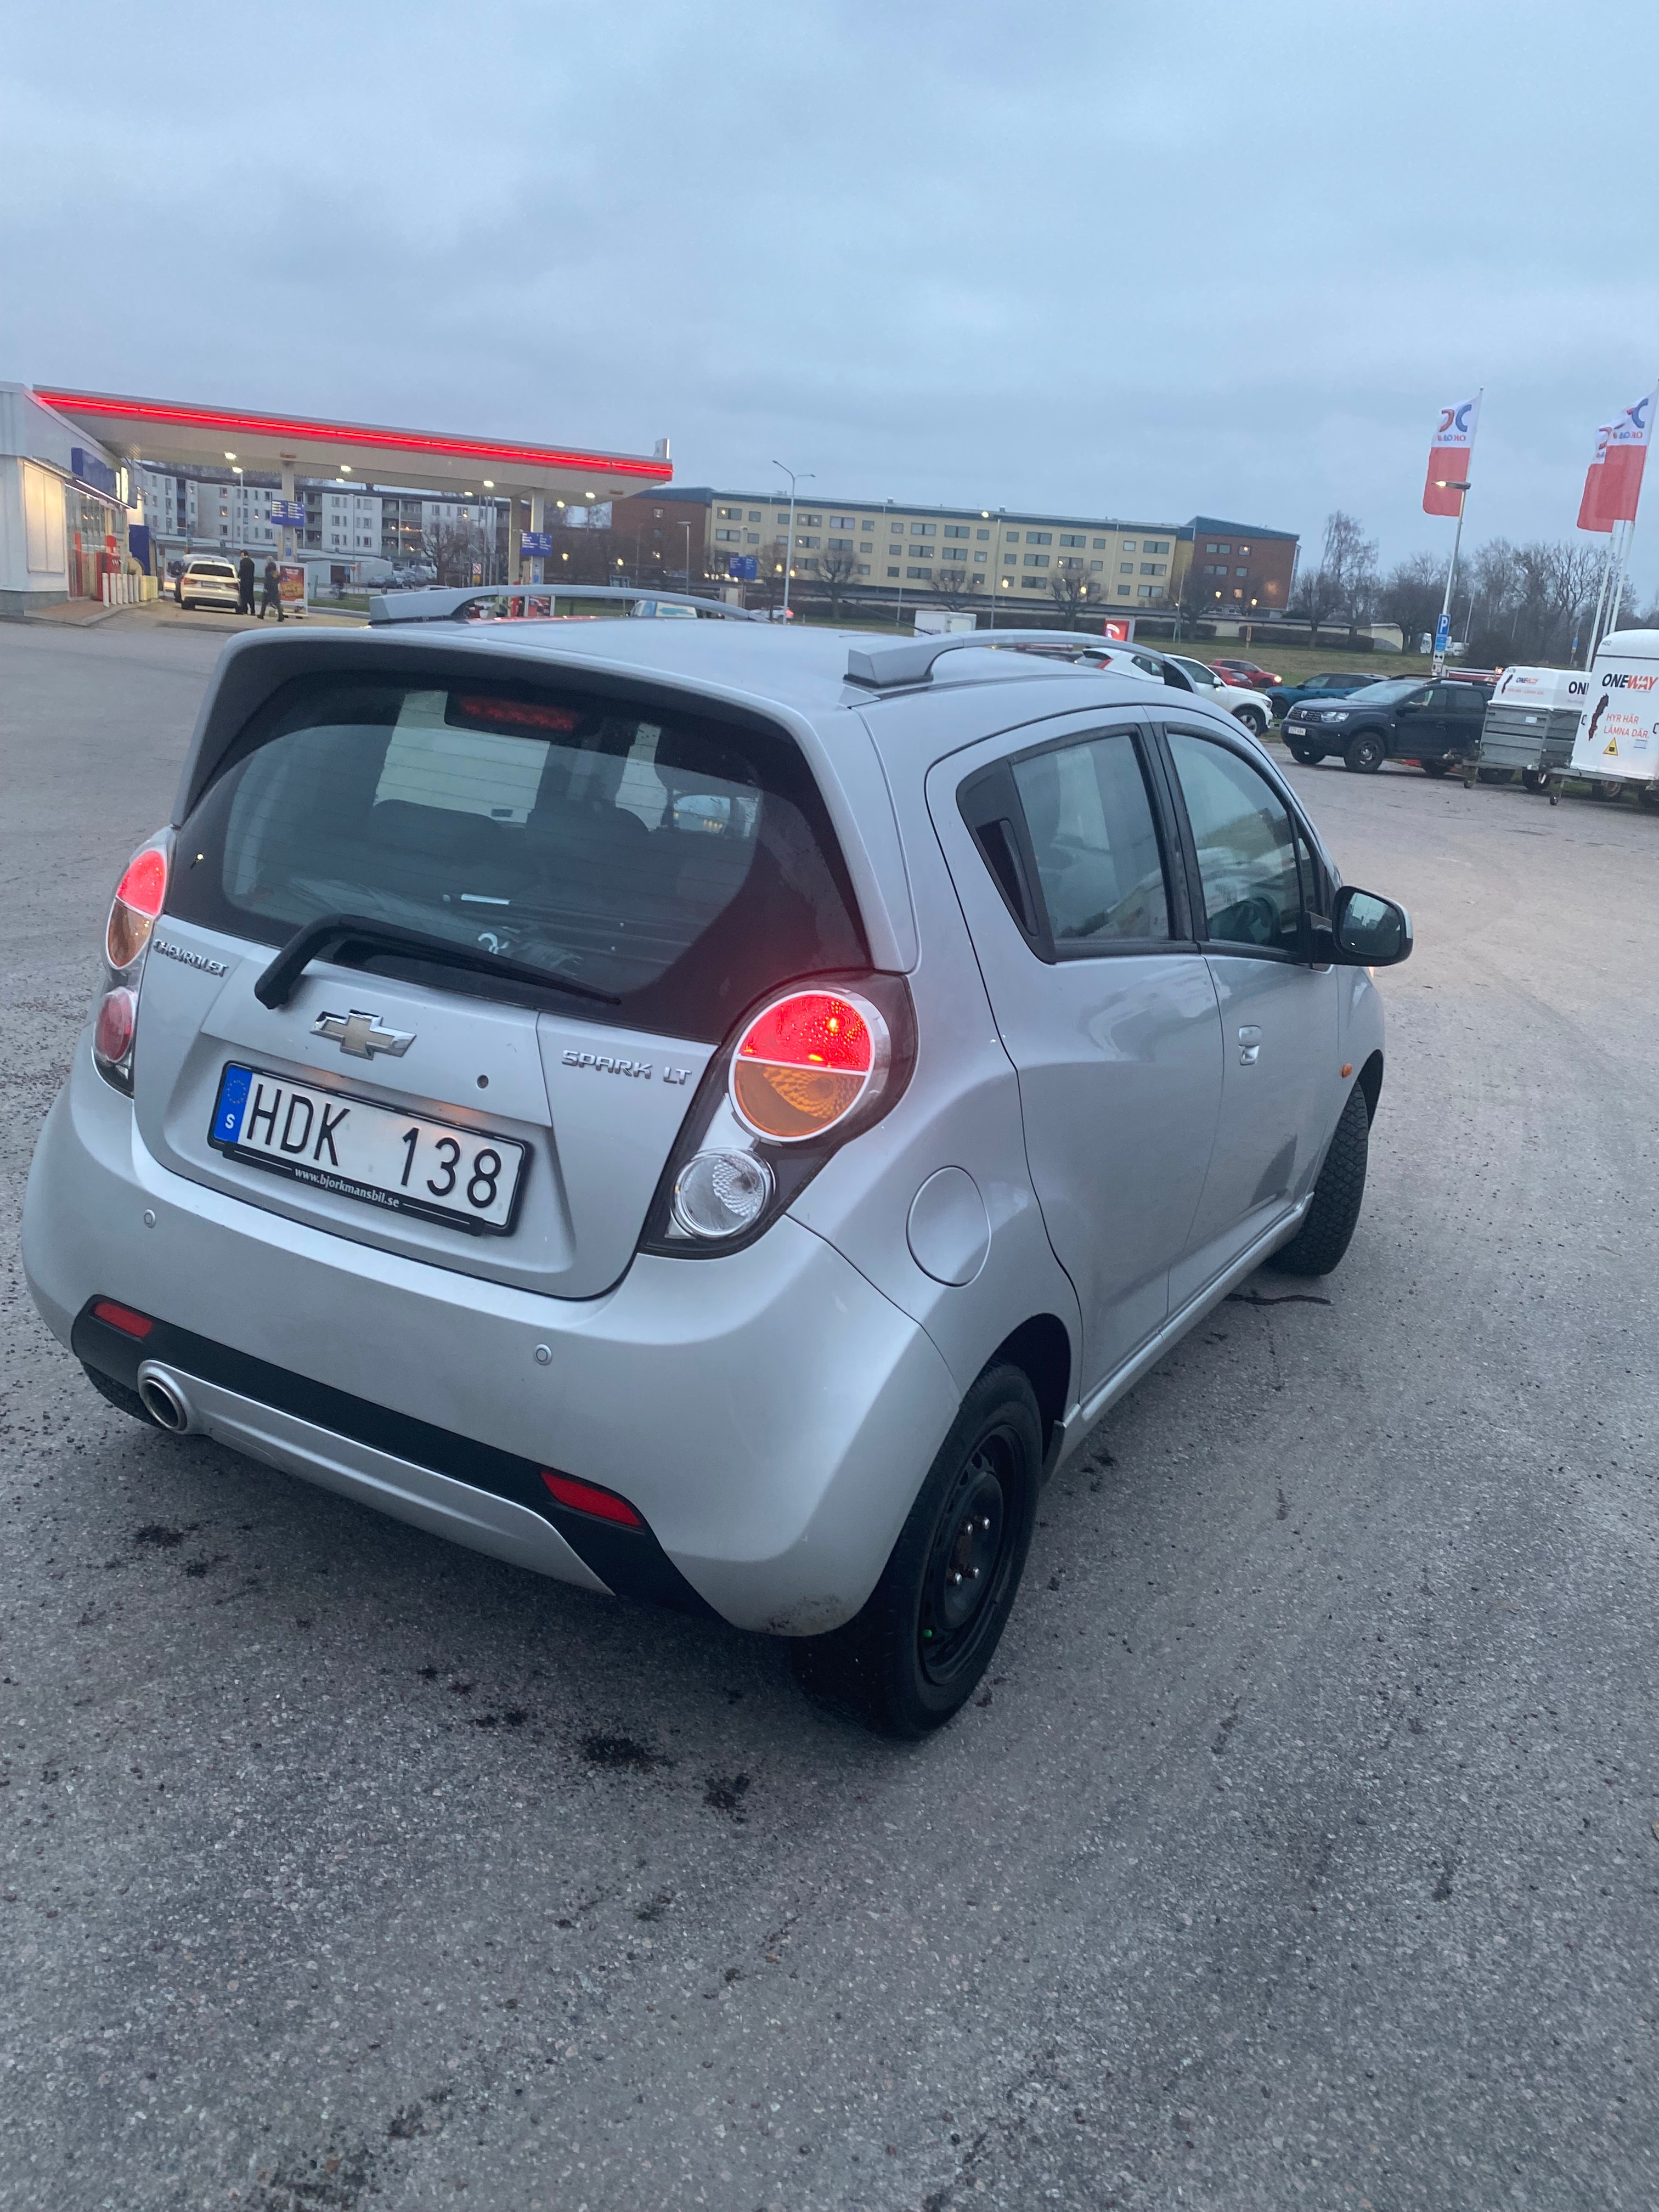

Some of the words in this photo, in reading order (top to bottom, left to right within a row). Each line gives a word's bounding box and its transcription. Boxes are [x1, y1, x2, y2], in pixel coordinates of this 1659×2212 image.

[1440, 617, 1448, 634] P
[1602, 673, 1658, 691] ONEWAY
[1606, 713, 1622, 722] HYR
[1623, 714, 1639, 725] HÄR
[1604, 724, 1629, 736] LÄMNA
[154, 939, 229, 977] CHEVROLET
[562, 1049, 653, 1079] SPARK
[663, 1066, 692, 1085] LT
[225, 1113, 235, 1128] S
[247, 1084, 351, 1166] HDK
[401, 1127, 501, 1208] 138
[295, 1168, 399, 1207] www.bjorkmansbil.se
